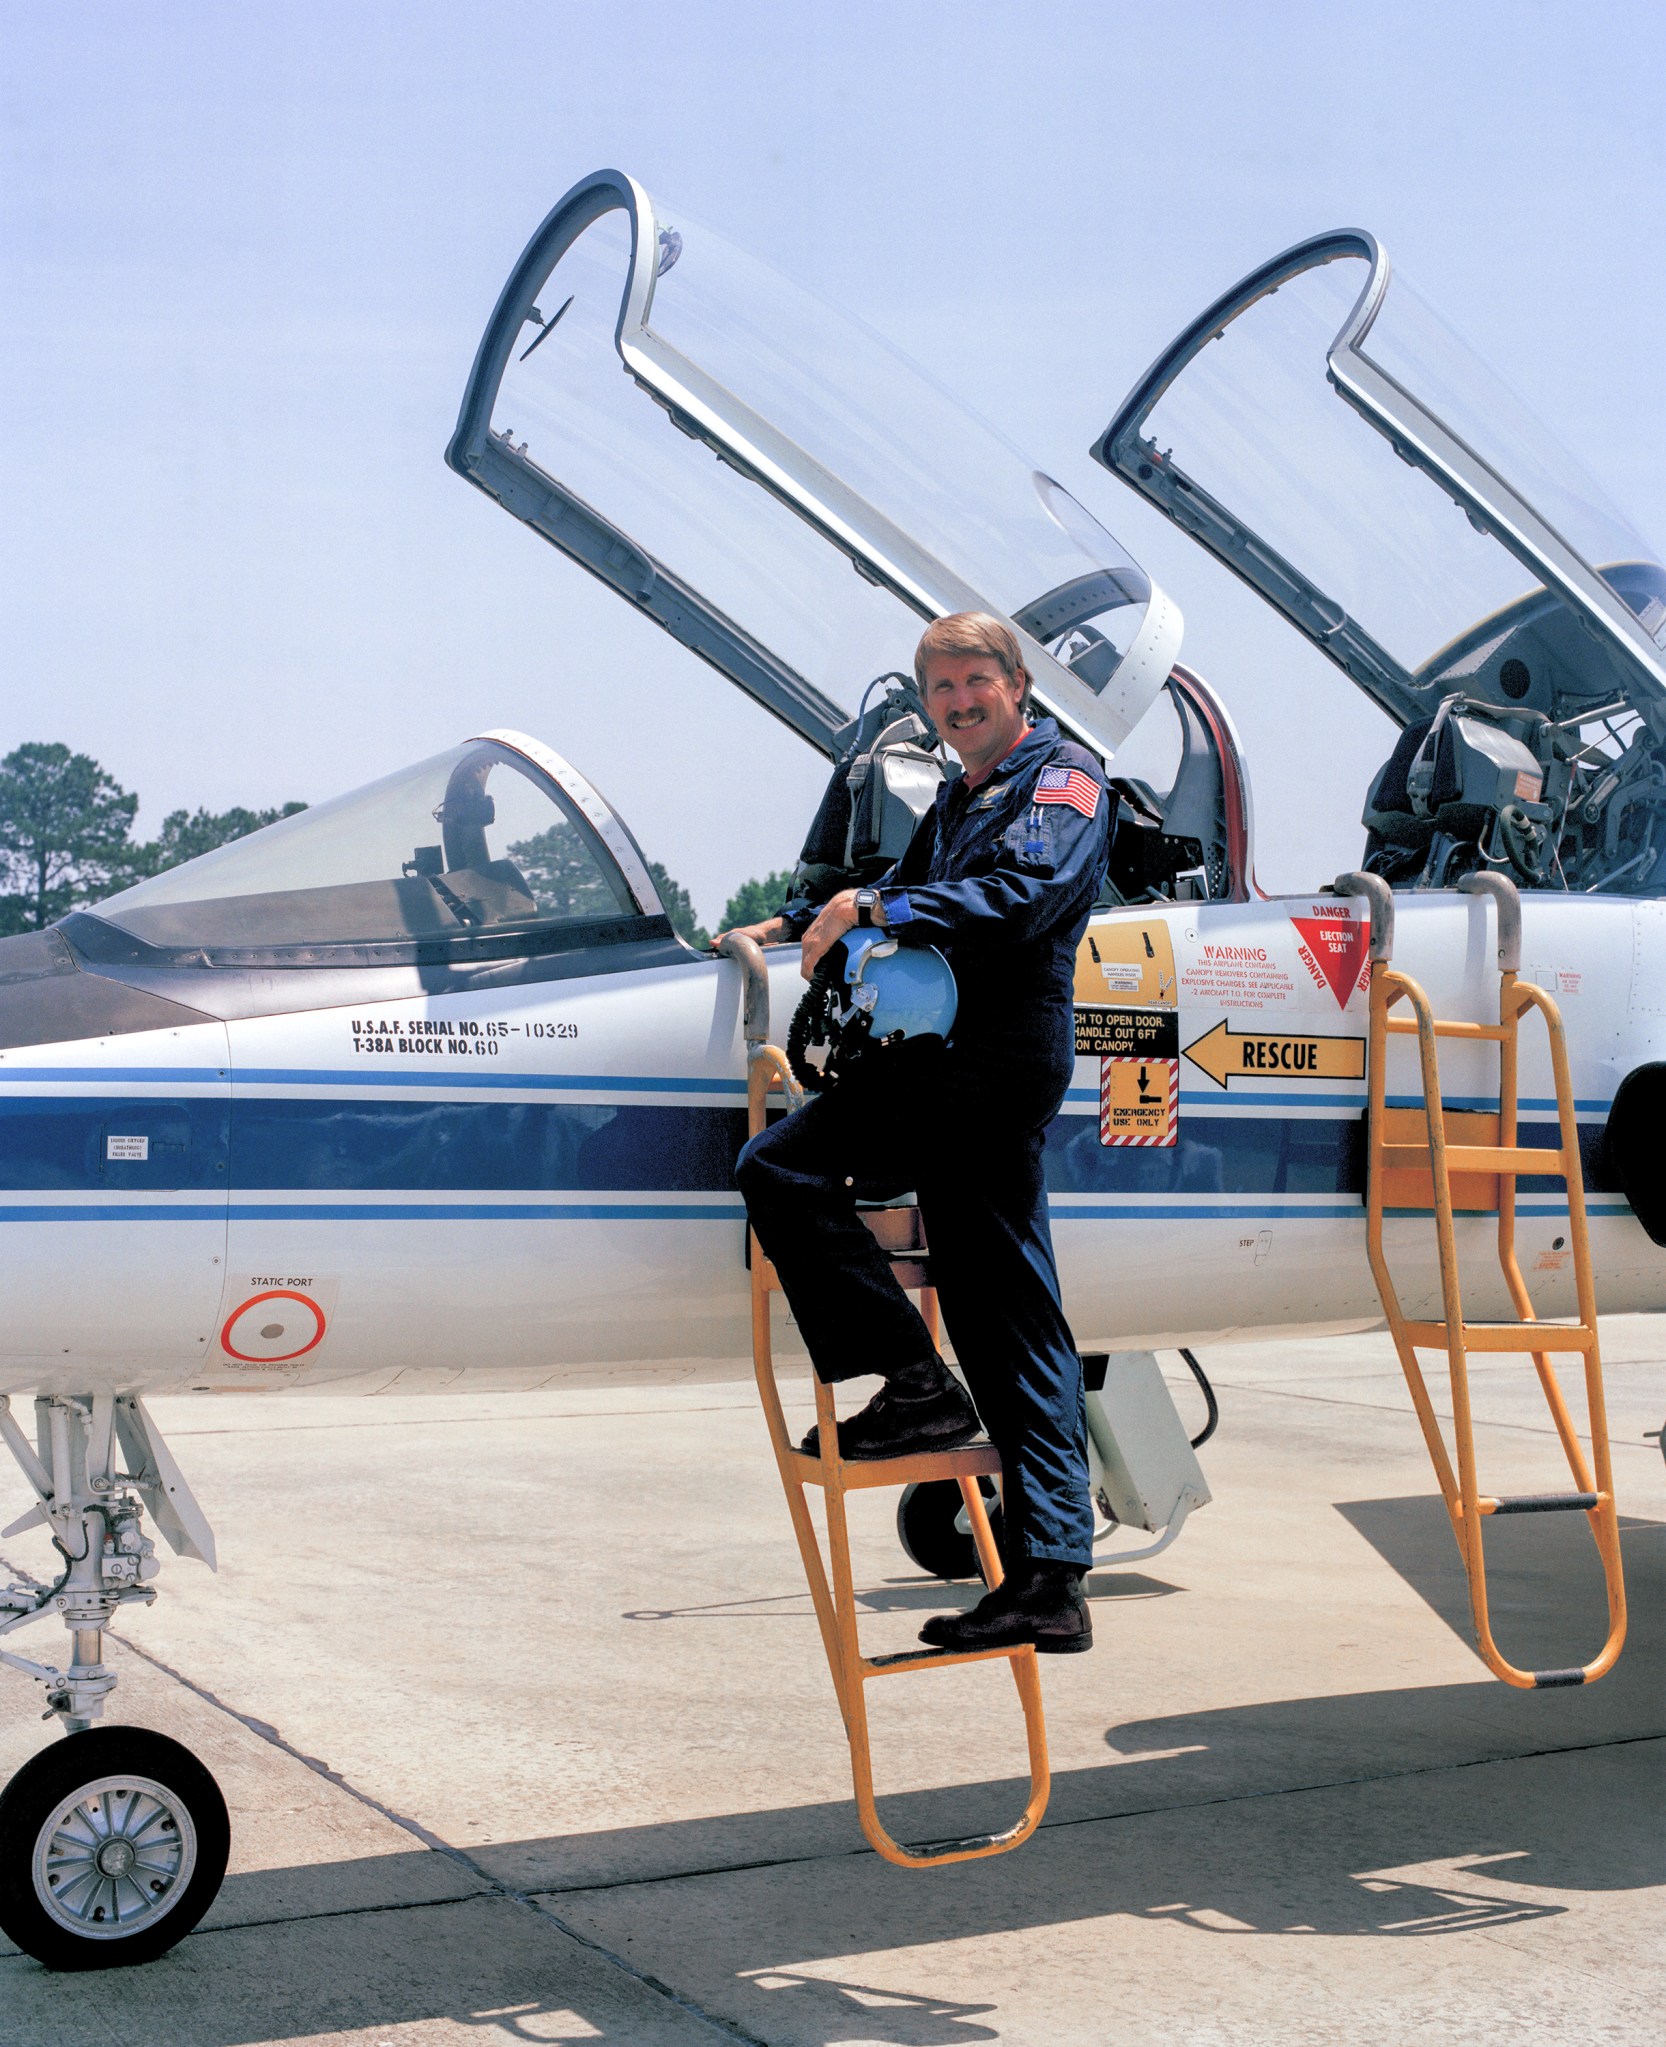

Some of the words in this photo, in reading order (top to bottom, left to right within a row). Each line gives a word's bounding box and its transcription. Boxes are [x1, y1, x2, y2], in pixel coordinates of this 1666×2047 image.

[1312, 906, 1351, 918] DANGER
[1320, 930, 1354, 942] EJECTION
[1204, 946, 1267, 961] WARNING
[1328, 943, 1346, 953] SEAT
[1298, 946, 1326, 989] DANGER
[1182, 978, 1214, 986] EXPLOSIVE
[1249, 972, 1288, 980] CONTAINING
[1090, 1014, 1102, 1024] TO
[1106, 1015, 1132, 1026] OPEN
[1136, 1016, 1165, 1027] DOOR.
[352, 1020, 404, 1035] U.S.A.F.
[409, 1021, 454, 1036] SERIAL
[459, 1022, 483, 1036] NO.
[487, 1022, 578, 1038] 65-10329
[1075, 1027, 1110, 1038] HANDLE
[1115, 1028, 1135, 1039] OUT
[354, 1038, 394, 1053] T-38A
[400, 1039, 443, 1054] BLOCK
[448, 1040, 472, 1054] NO.
[476, 1040, 498, 1055] 60
[1095, 1040, 1136, 1051] CANOPY.
[1243, 1041, 1318, 1070] RESCUE
[251, 1277, 283, 1287] STATIC
[287, 1278, 313, 1287] PORT
